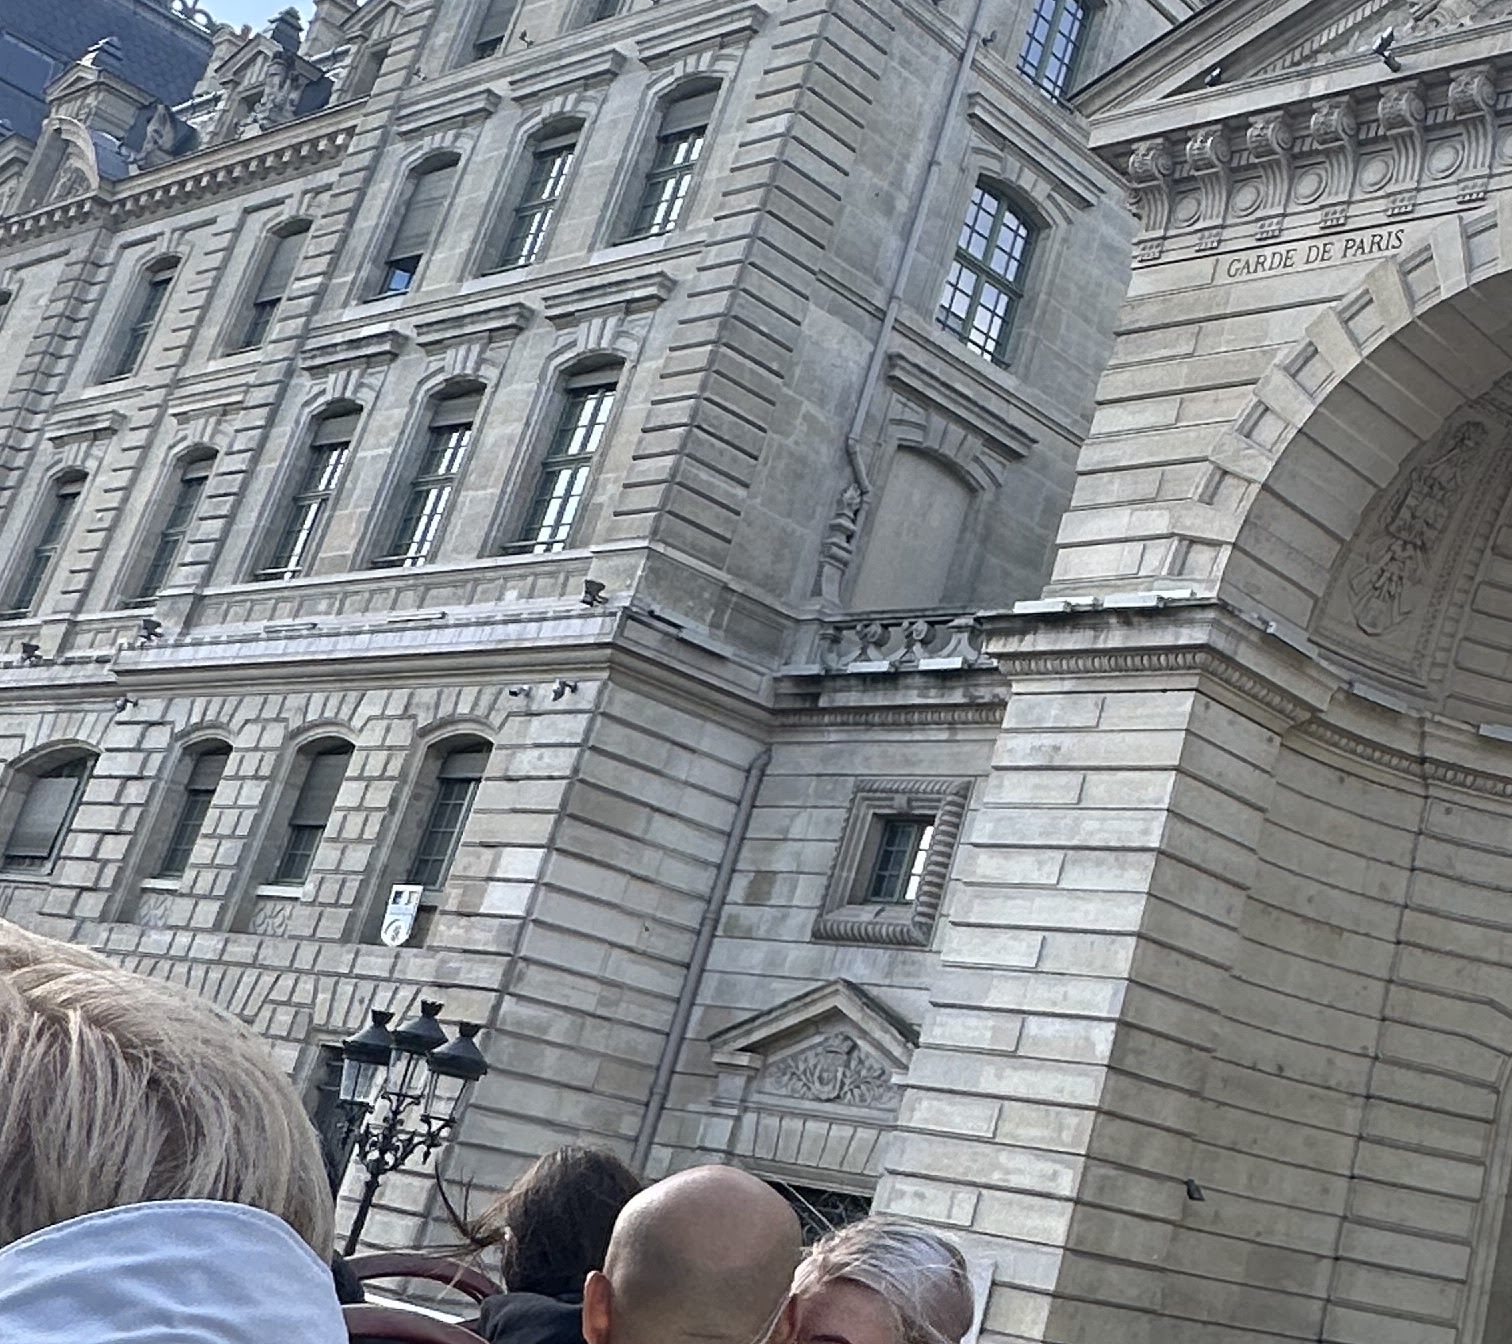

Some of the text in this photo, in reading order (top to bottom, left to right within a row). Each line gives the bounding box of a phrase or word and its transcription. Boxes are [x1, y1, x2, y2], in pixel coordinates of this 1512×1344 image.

[1226, 229, 1405, 278] GARDE DE PARIS
